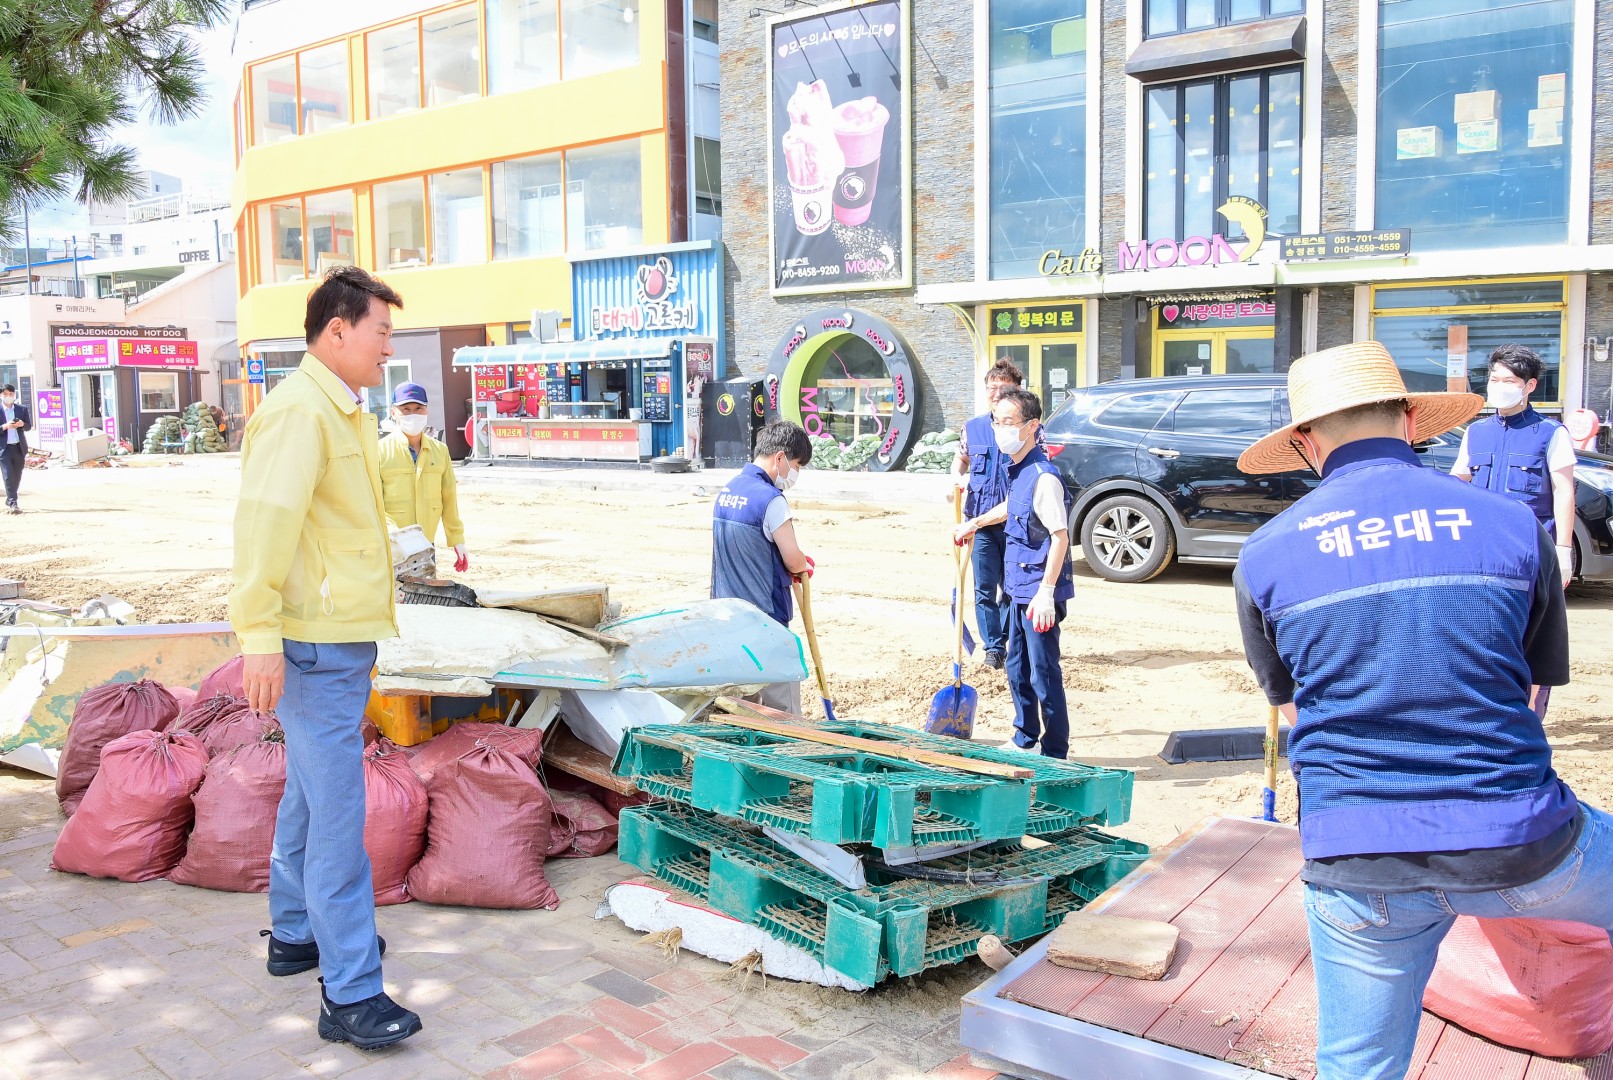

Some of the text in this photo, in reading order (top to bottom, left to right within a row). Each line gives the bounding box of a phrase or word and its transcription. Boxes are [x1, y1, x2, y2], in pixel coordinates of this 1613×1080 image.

[851, 24, 883, 40] 입니다
[1334, 232, 1401, 244] 051-701-4559
[179, 250, 210, 263] COFFEE
[1038, 233, 1245, 276] Cafe MOON
[1333, 243, 1401, 254] 010-4559-4559
[782, 264, 840, 279] 010-8458-9200
[602, 306, 640, 329] 대게
[645, 302, 694, 327] 고로케
[1017, 310, 1075, 328] 행복의 문
[1182, 303, 1237, 321] 사랑의문
[821, 318, 847, 328] MOON
[58, 328, 139, 337] SONGJEONGDONG
[144, 329, 161, 337] HOT
[866, 328, 888, 352] MOON
[135, 344, 152, 355] 사주
[153, 346, 159, 354] &
[160, 344, 177, 355] 타로
[783, 334, 803, 357] MOON
[477, 379, 505, 389] 떡볶이
[895, 374, 906, 405] MOON
[770, 379, 778, 410] MOON
[879, 427, 899, 456] MOON
[1315, 508, 1473, 558] 해운대구
